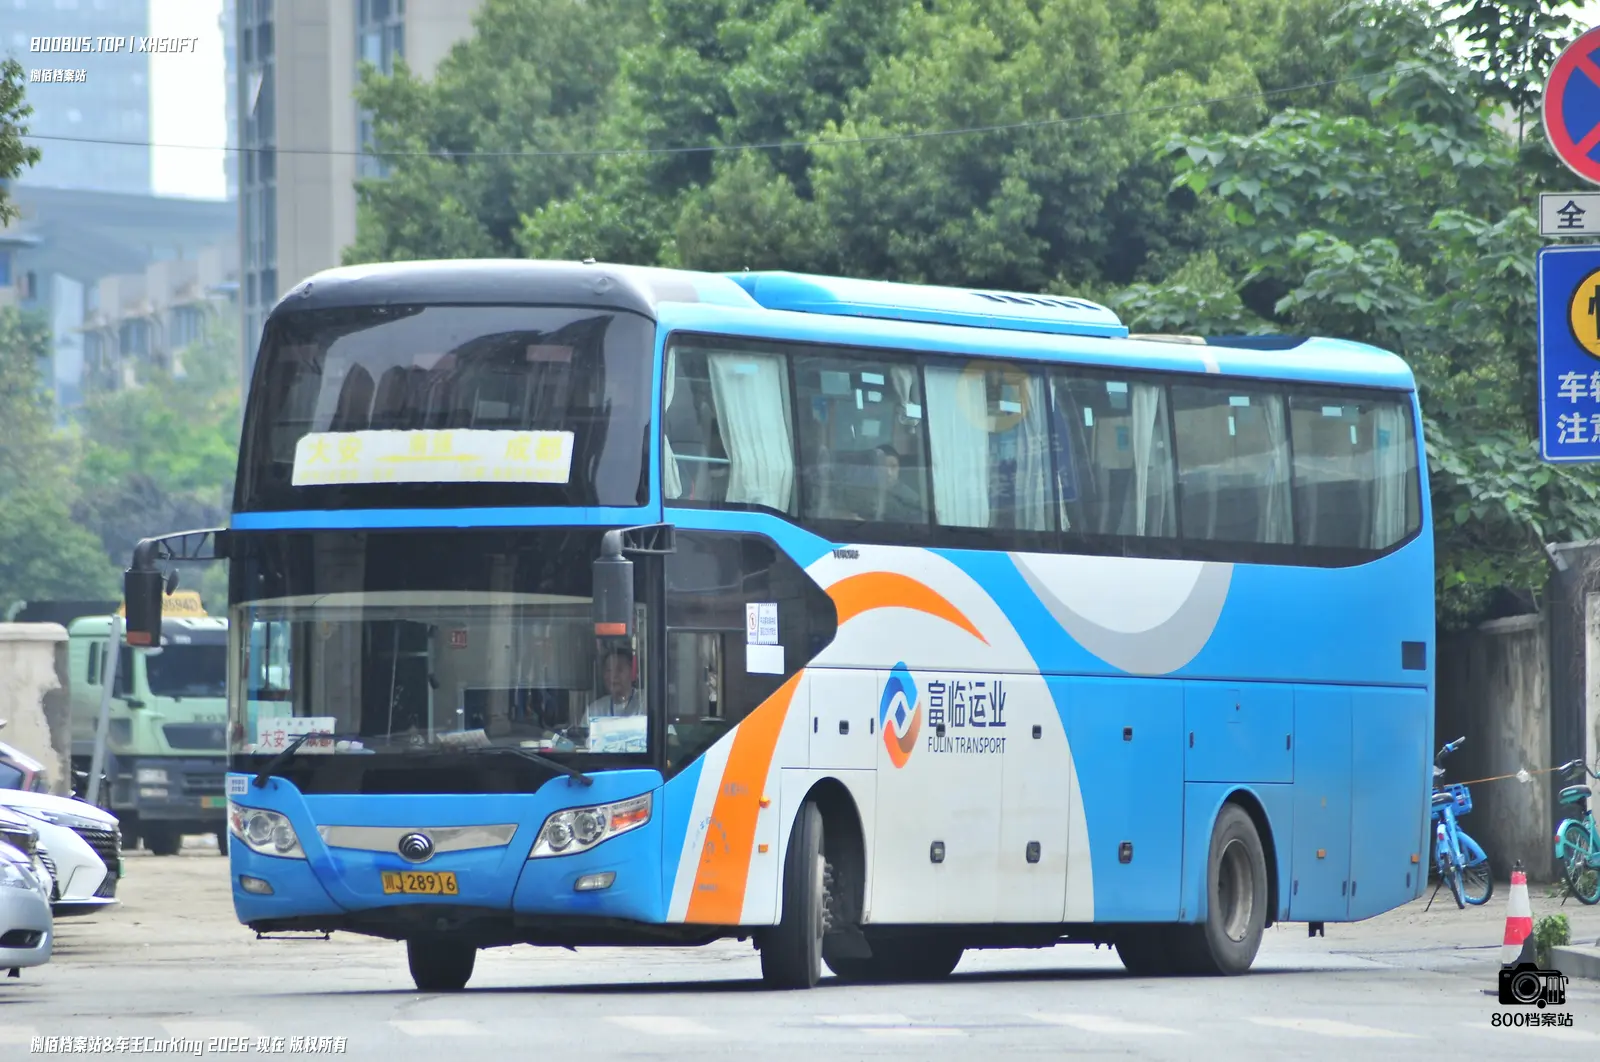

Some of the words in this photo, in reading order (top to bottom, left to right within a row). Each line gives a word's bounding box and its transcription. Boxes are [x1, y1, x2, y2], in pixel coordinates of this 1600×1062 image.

[1557, 200, 1586, 229] 全
[928, 680, 1006, 728] 富临运业
[261, 730, 285, 748] 大安
[928, 736, 953, 753] FULIN
[956, 737, 1006, 753] TRANSPORT
